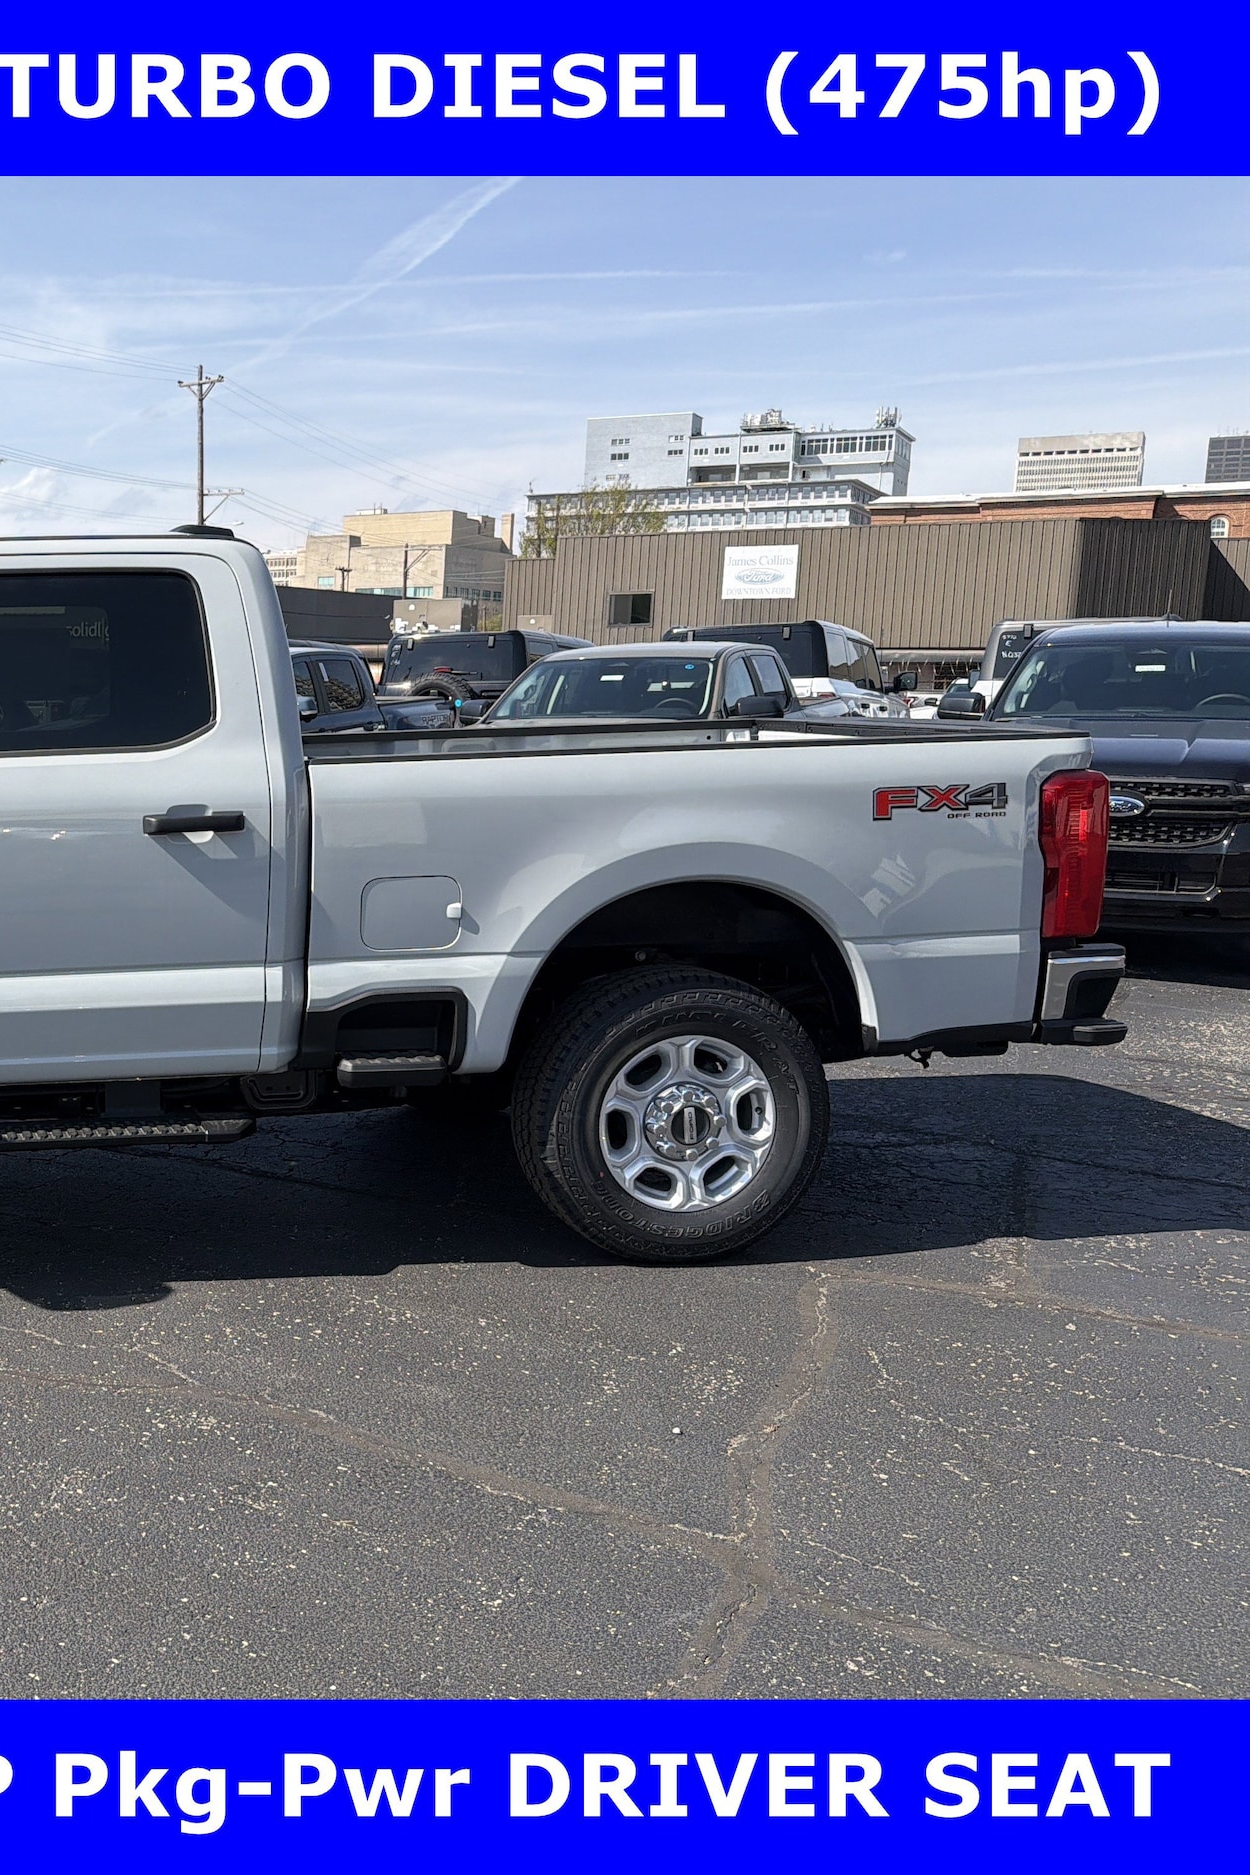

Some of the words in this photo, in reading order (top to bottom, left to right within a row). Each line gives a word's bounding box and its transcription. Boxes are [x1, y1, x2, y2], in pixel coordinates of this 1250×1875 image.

[727, 556, 757, 567] James
[759, 554, 794, 566] Collins
[741, 569, 777, 583] Ford
[726, 587, 770, 596] DOWNTOWN
[771, 587, 792, 595] FORD
[872, 782, 1009, 822] FX4
